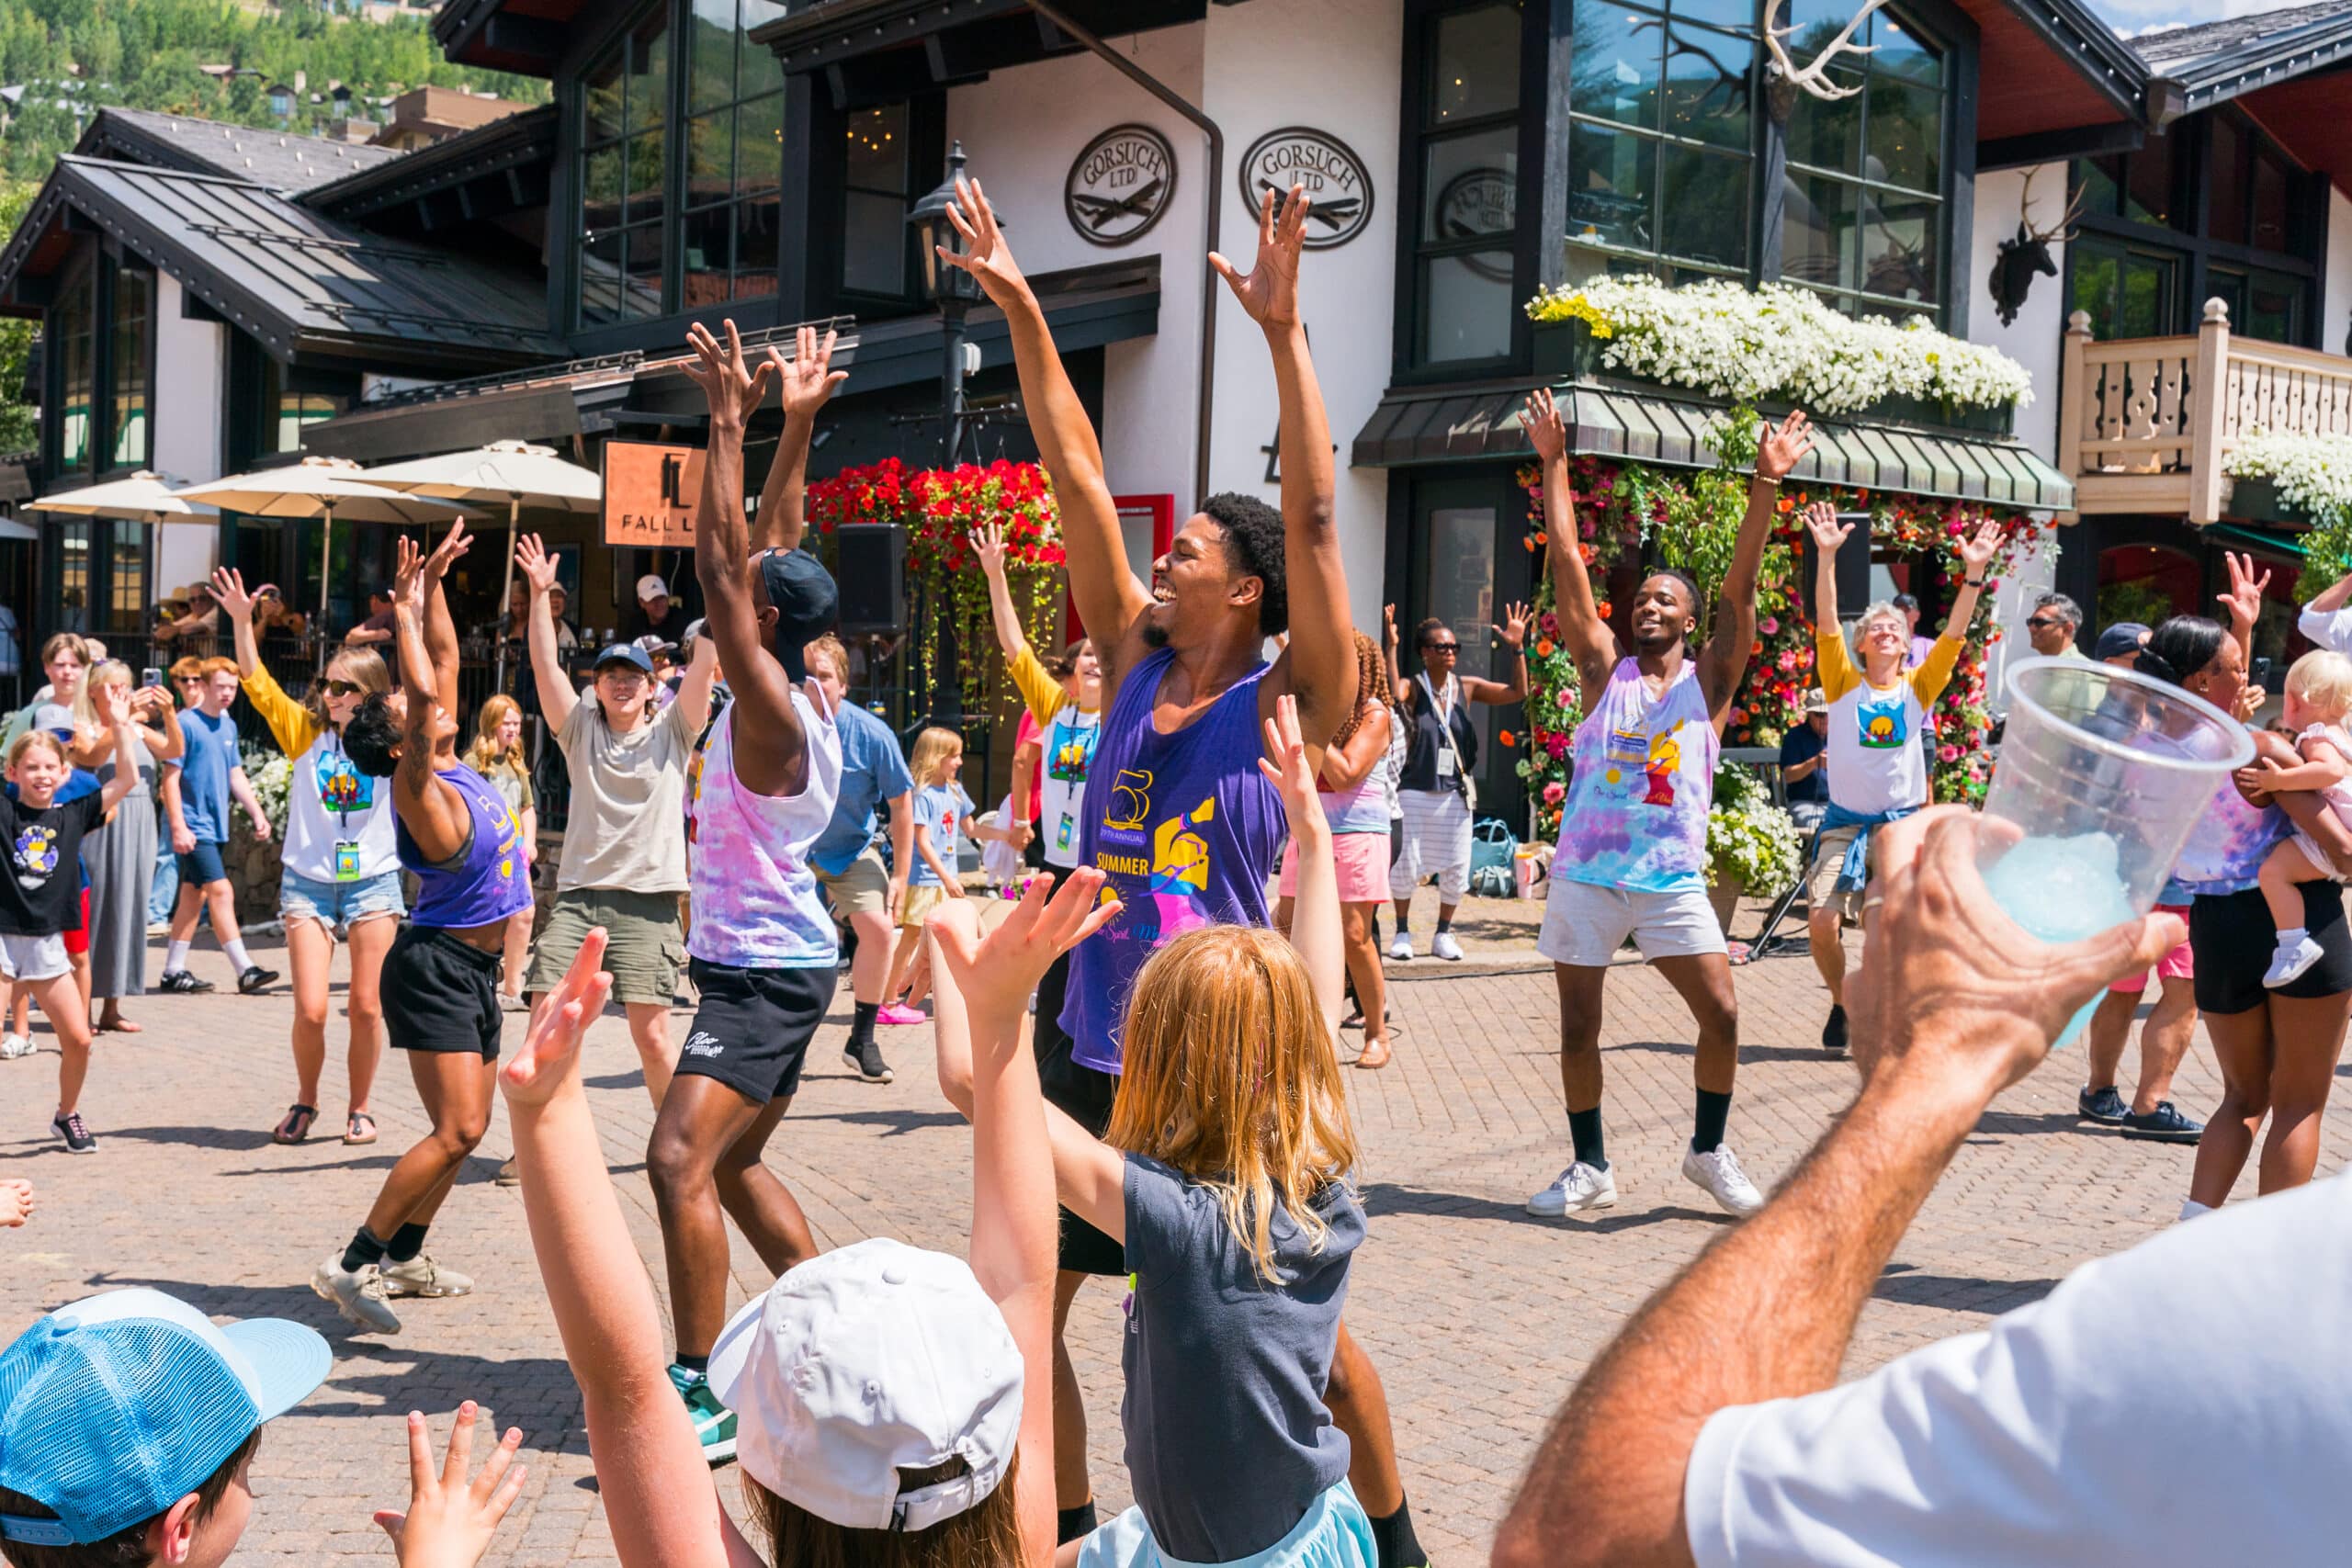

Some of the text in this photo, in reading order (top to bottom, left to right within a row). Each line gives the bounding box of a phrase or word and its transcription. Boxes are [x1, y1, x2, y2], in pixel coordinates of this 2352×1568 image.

[1084, 141, 1162, 186] GORSUCH
[1262, 145, 1356, 191] GORSUCH
[1110, 167, 1136, 188] LTD
[1293, 170, 1324, 190] LTD
[622, 514, 673, 532] FALL
[1096, 852, 1148, 876] SUMMER
